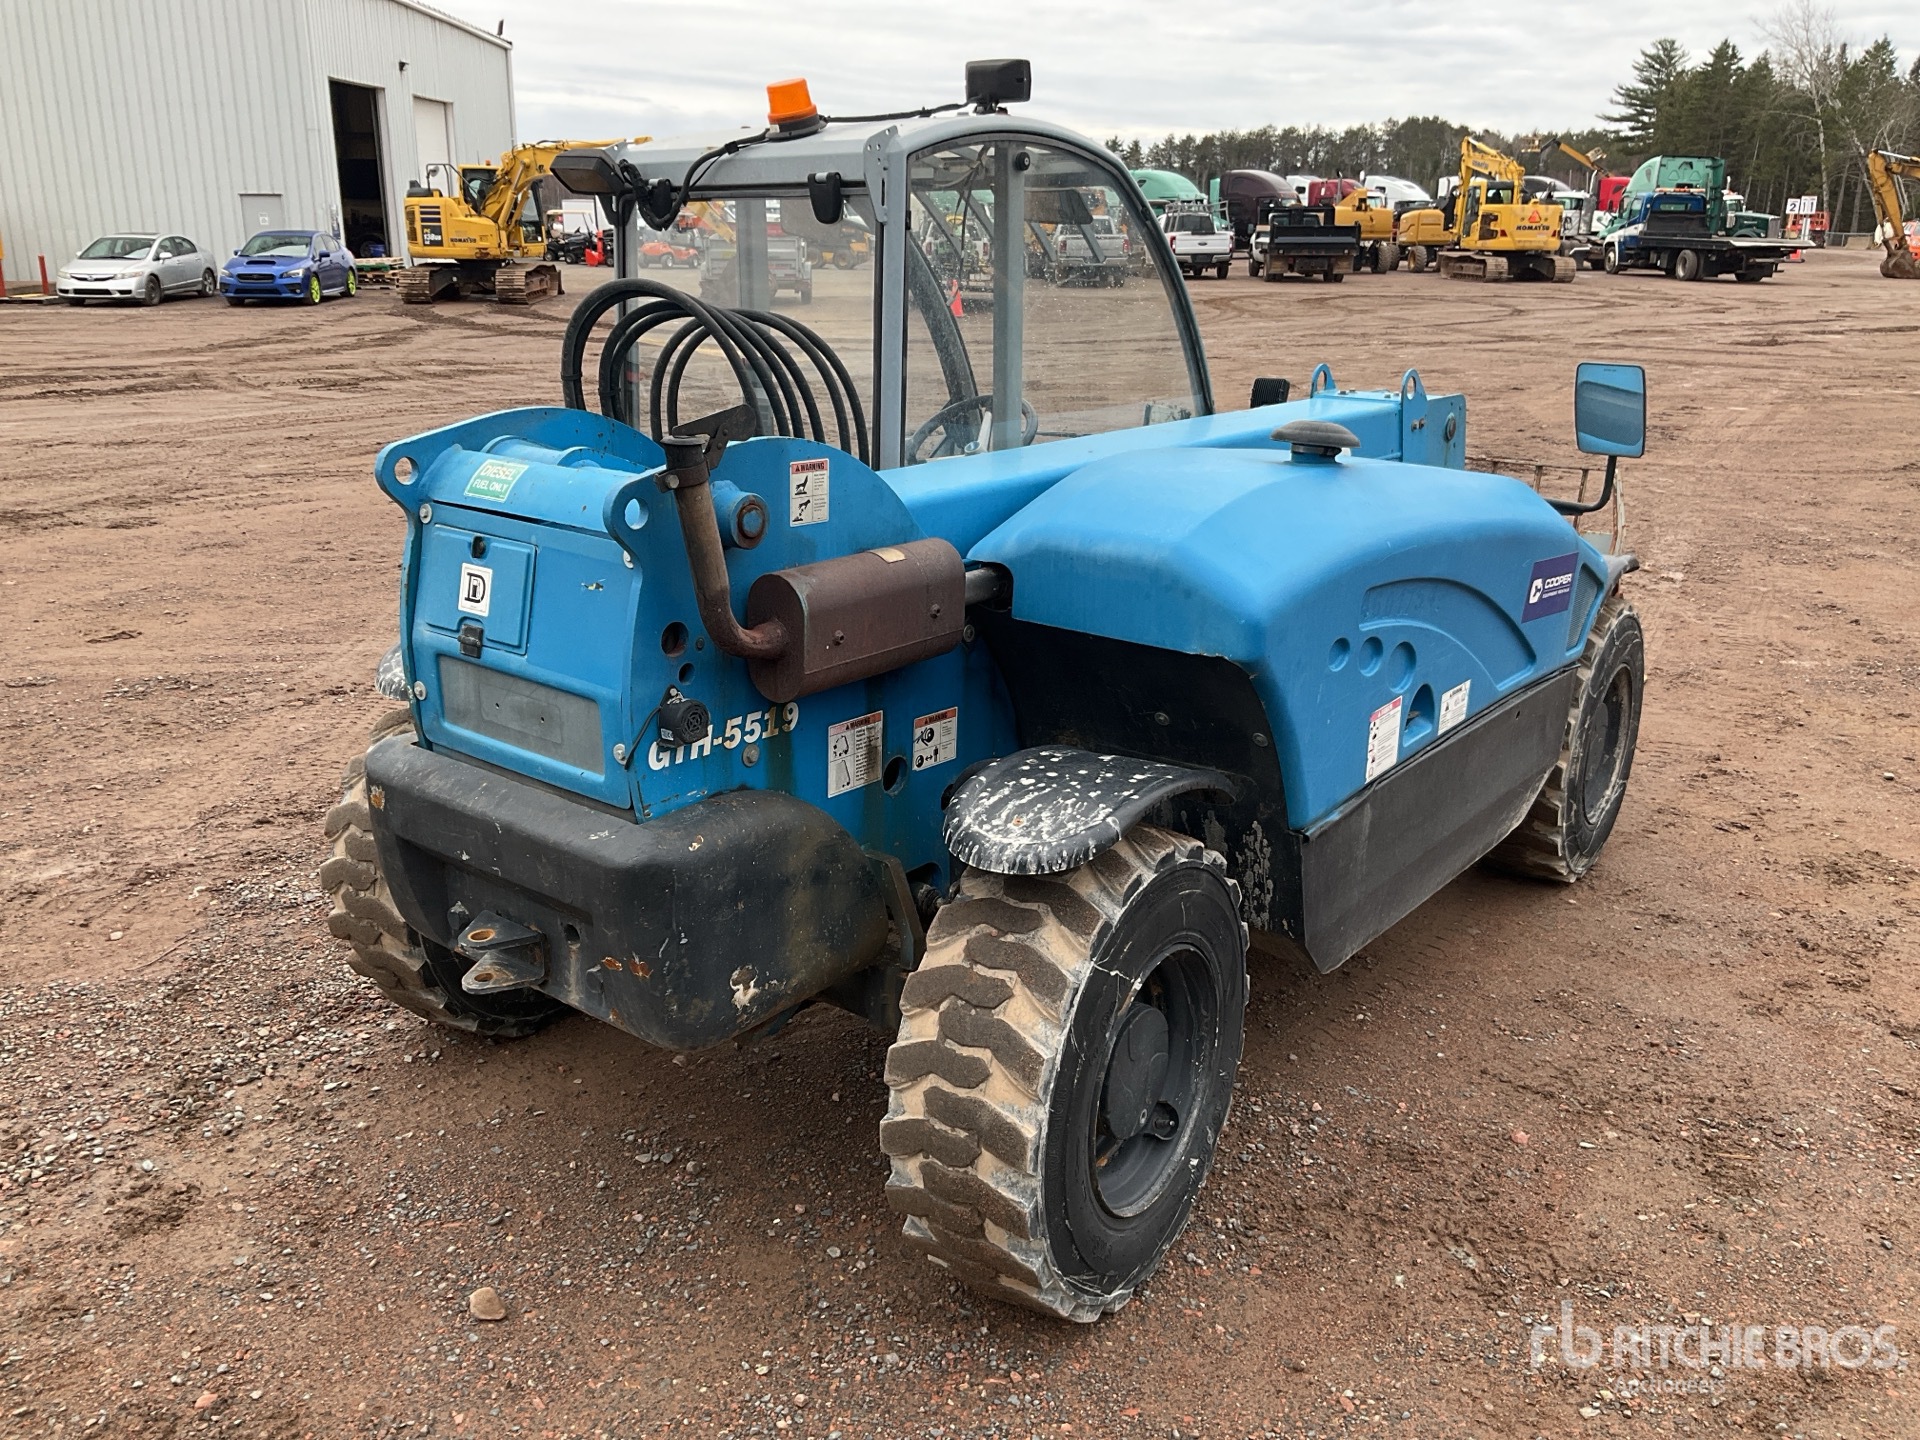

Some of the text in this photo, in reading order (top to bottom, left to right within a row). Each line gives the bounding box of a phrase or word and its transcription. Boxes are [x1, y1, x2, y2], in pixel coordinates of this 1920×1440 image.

[1789, 202, 1796, 211] 2
[1515, 223, 1550, 231] KOMATSU
[480, 465, 516, 480] DIESEL
[800, 462, 825, 472] WARNING
[472, 478, 509, 492] FUEL ONLY
[1544, 573, 1573, 589] COOPER
[850, 717, 871, 730] WARNING
